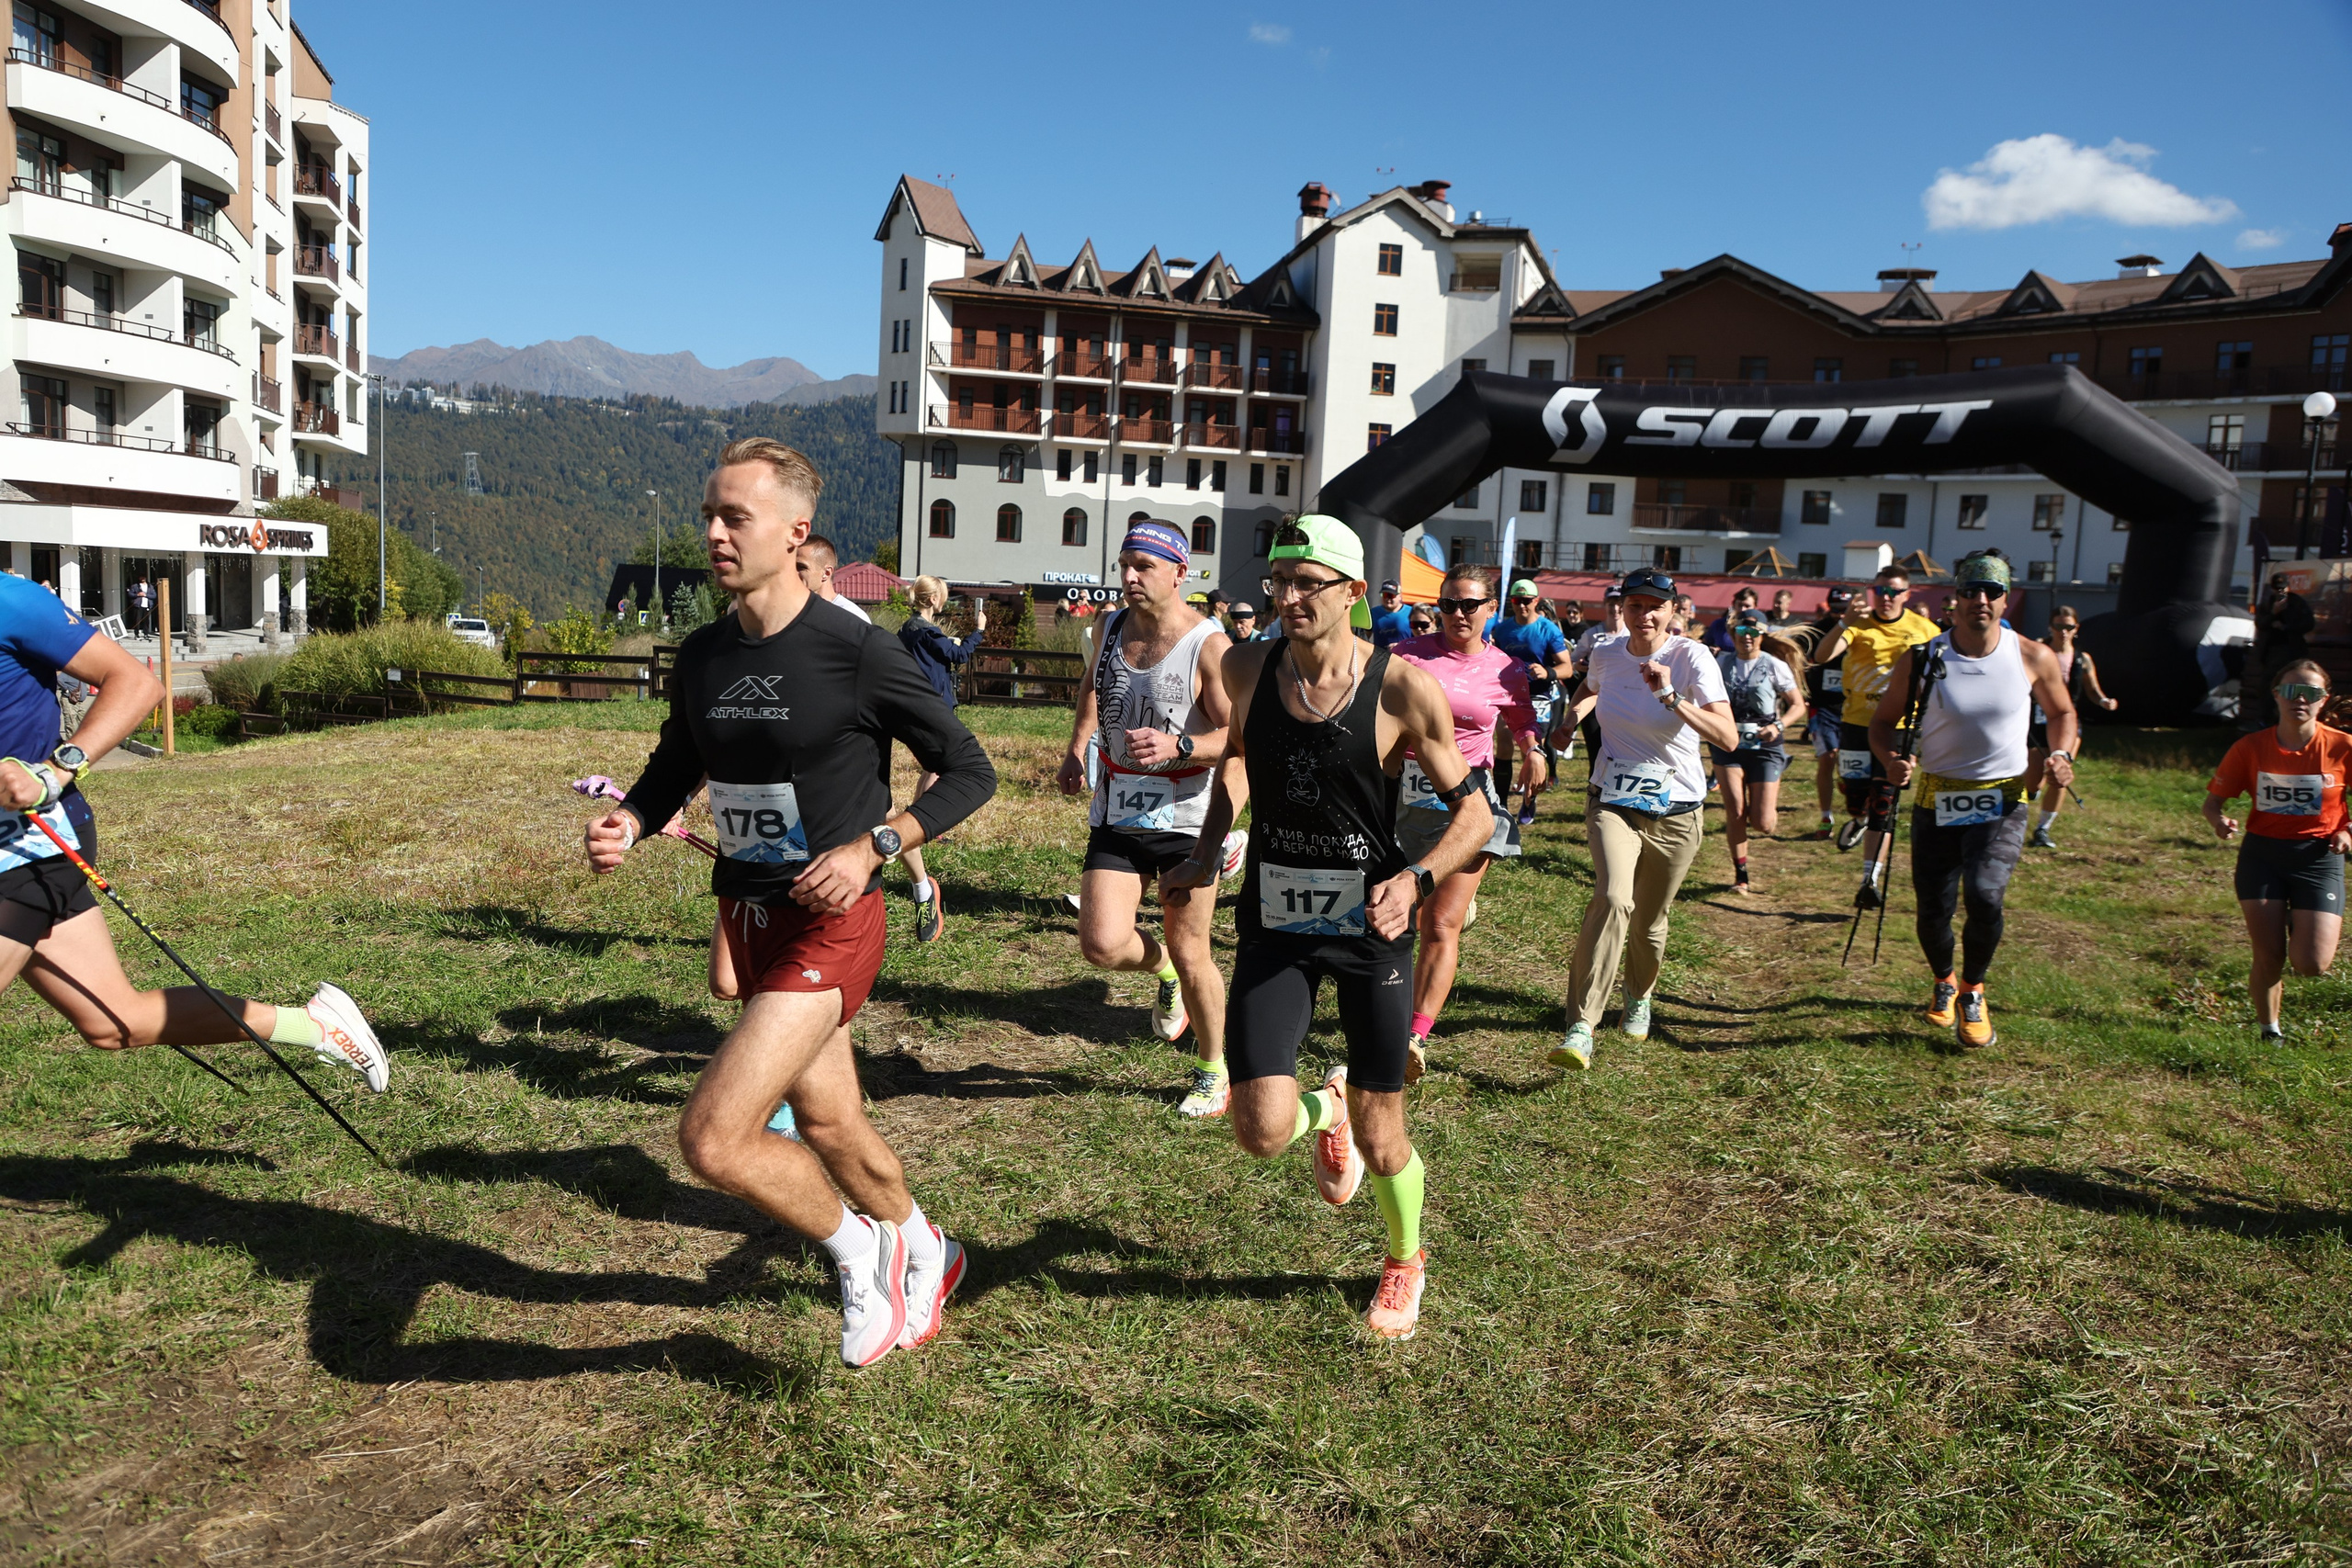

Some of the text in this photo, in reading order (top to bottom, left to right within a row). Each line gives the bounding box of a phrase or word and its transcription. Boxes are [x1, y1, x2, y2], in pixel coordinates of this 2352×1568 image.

[1623, 400, 1994, 448] SCOTT
[199, 525, 313, 552] ROSA SPRINGS
[1044, 571, 1086, 582] ПРОКАТ
[1156, 682, 1184, 694] SOCHI
[1827, 676, 1842, 685] 17
[1156, 692, 1183, 701] TEAM
[706, 706, 790, 719] ATHLEX
[1842, 759, 1862, 771] 112
[1408, 774, 1436, 795] 16
[1613, 773, 1661, 797] 172
[2263, 785, 2314, 803] 155
[1116, 790, 1164, 811] 147
[1941, 795, 1996, 812] 106
[720, 807, 787, 840] 178
[1262, 822, 1370, 848] Я ЖИВ ПОКУДА,
[1271, 837, 1369, 861] Я ВЕРЮ В ЧУДО
[76, 861, 104, 886] LEKI
[1281, 888, 1341, 915] 117
[328, 1027, 376, 1074] TERREX
